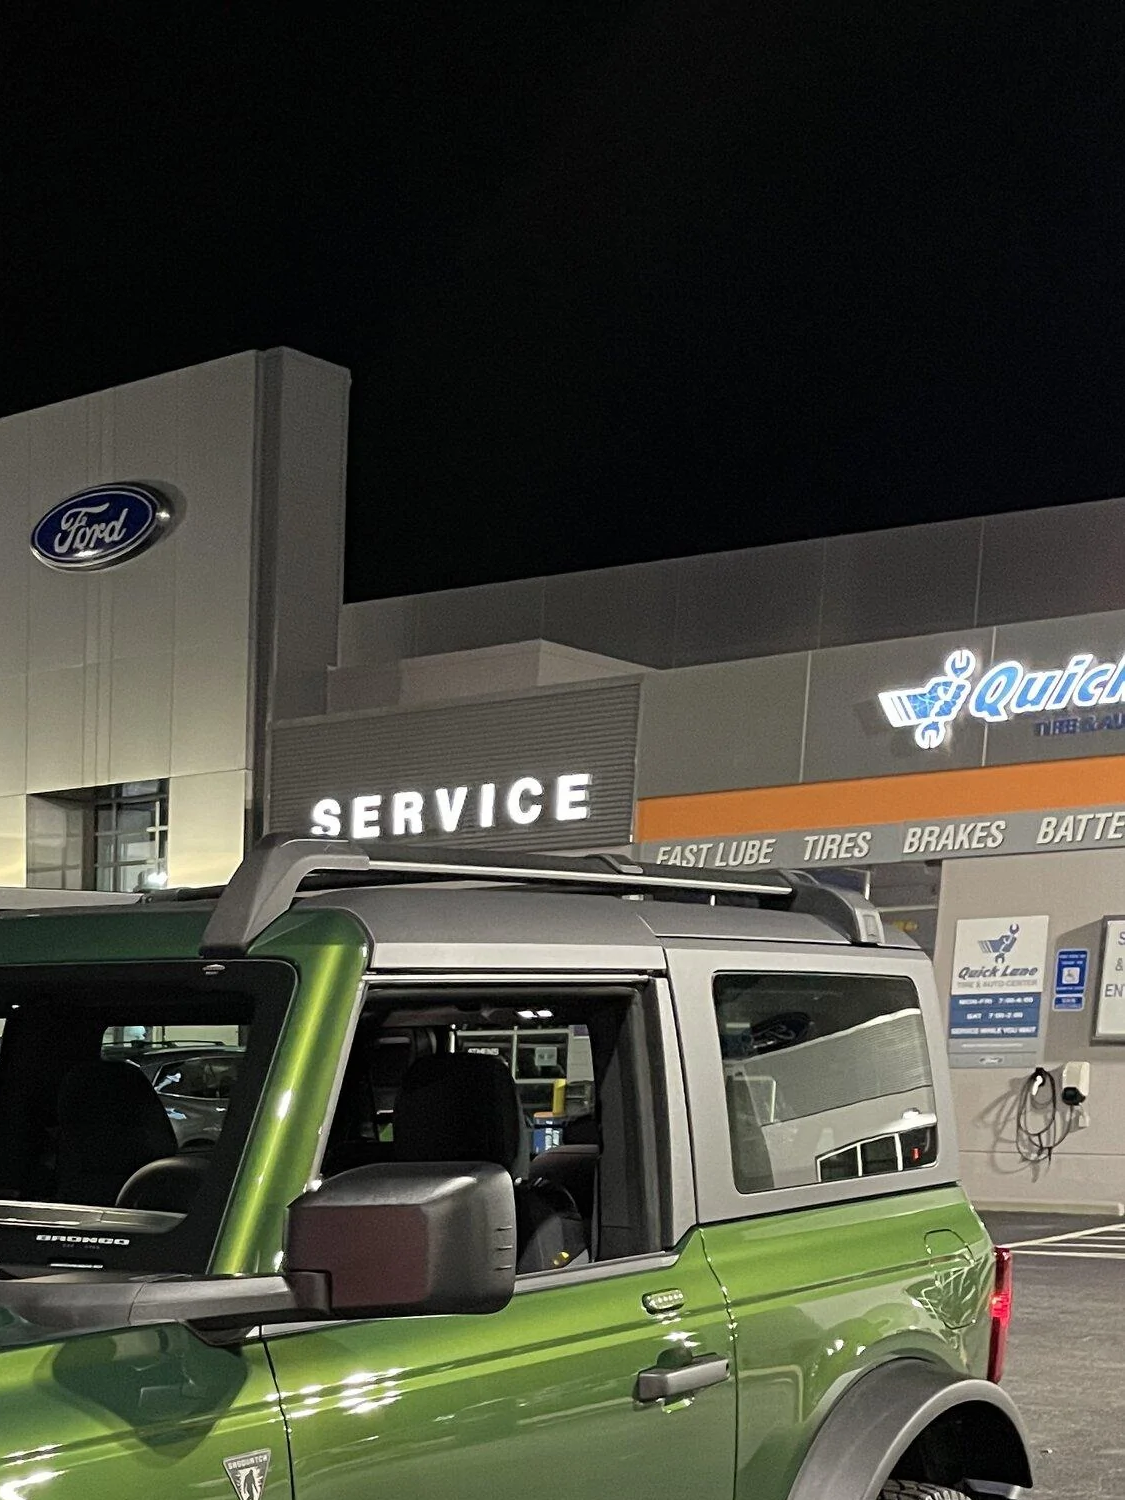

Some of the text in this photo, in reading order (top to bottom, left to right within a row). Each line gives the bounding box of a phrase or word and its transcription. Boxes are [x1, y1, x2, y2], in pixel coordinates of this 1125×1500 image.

[53, 502, 128, 553] Ford
[310, 774, 592, 839] SERVICE
[656, 843, 713, 868] FAST
[715, 838, 777, 868] LUBE
[804, 831, 872, 861] TIRES
[903, 820, 1007, 853] BRAKES
[958, 965, 1038, 980] Quick Lane
[1105, 983, 1125, 998] EN
[36, 1234, 130, 1246] BRONCO
